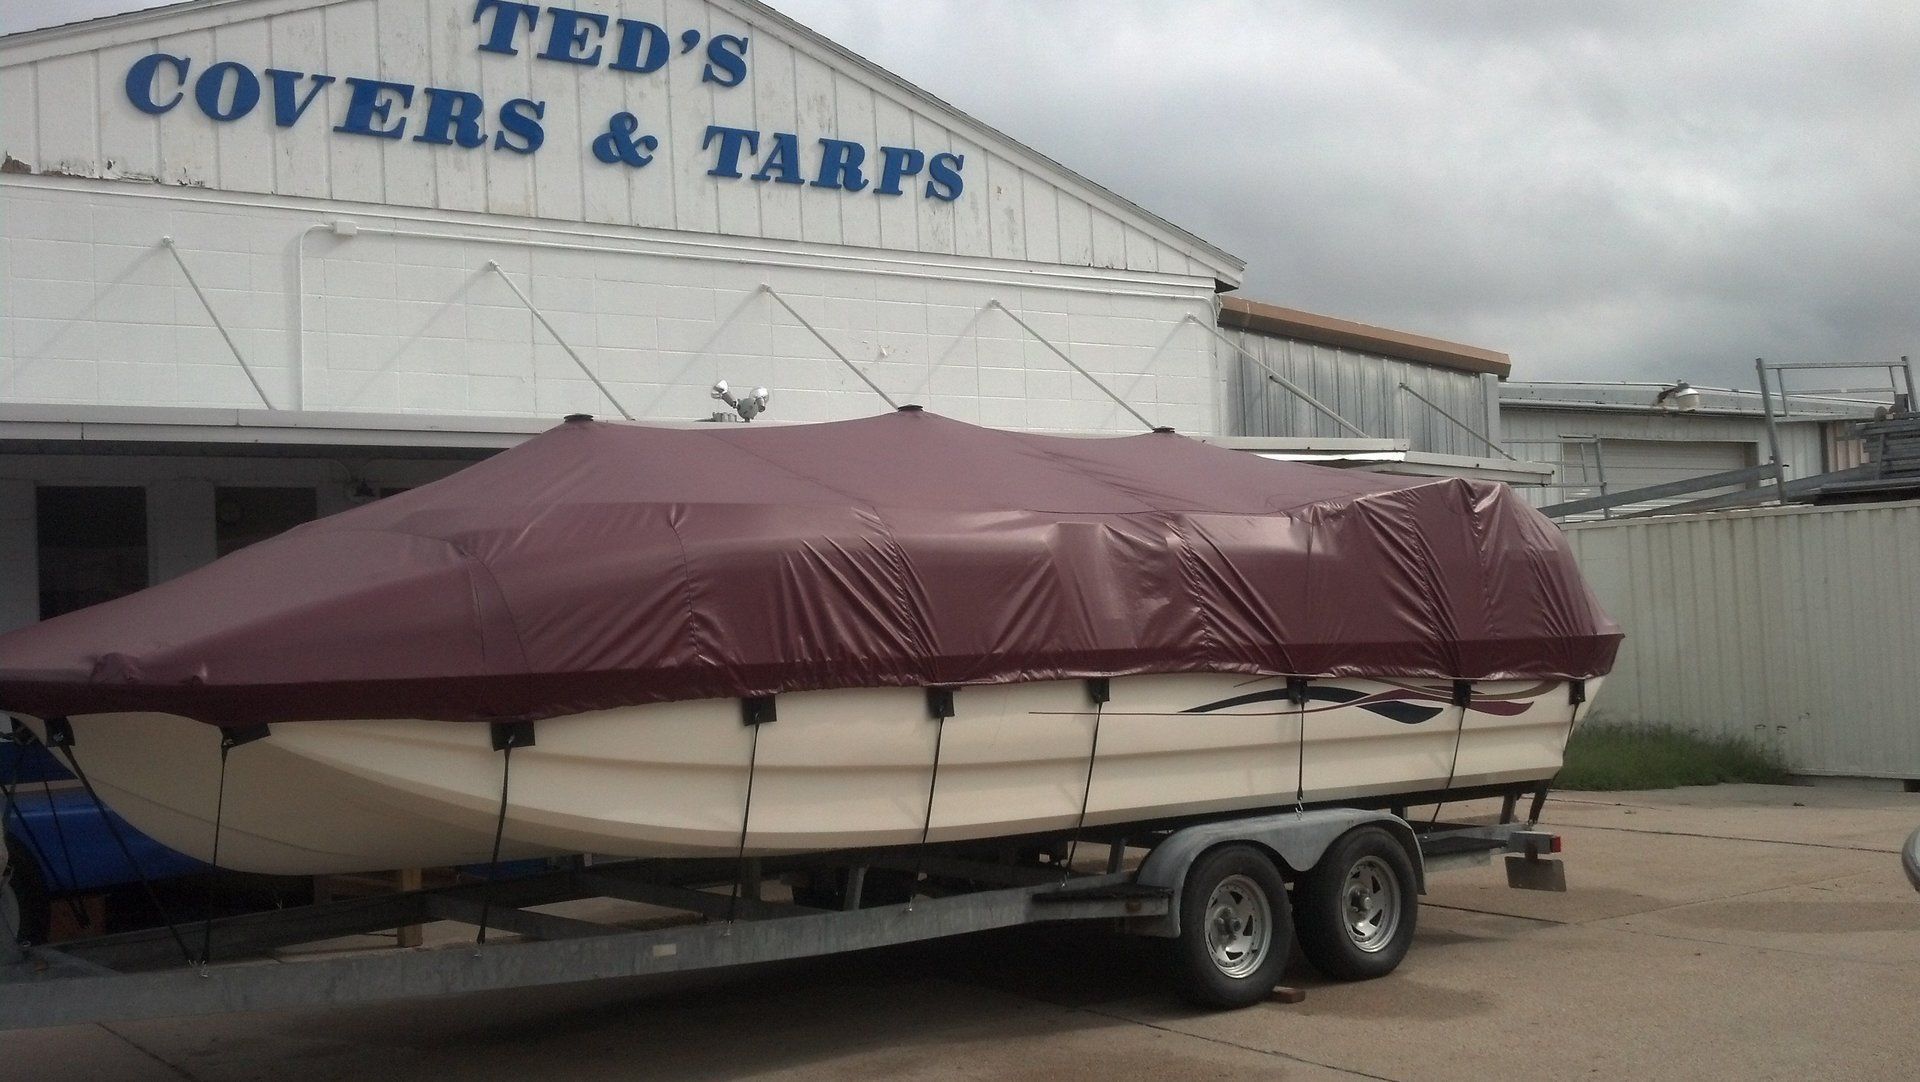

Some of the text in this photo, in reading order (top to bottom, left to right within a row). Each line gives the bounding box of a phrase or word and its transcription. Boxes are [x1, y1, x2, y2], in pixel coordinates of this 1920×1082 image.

[473, 0, 749, 87] TED'S
[125, 53, 965, 202] COVERS & TARPS
